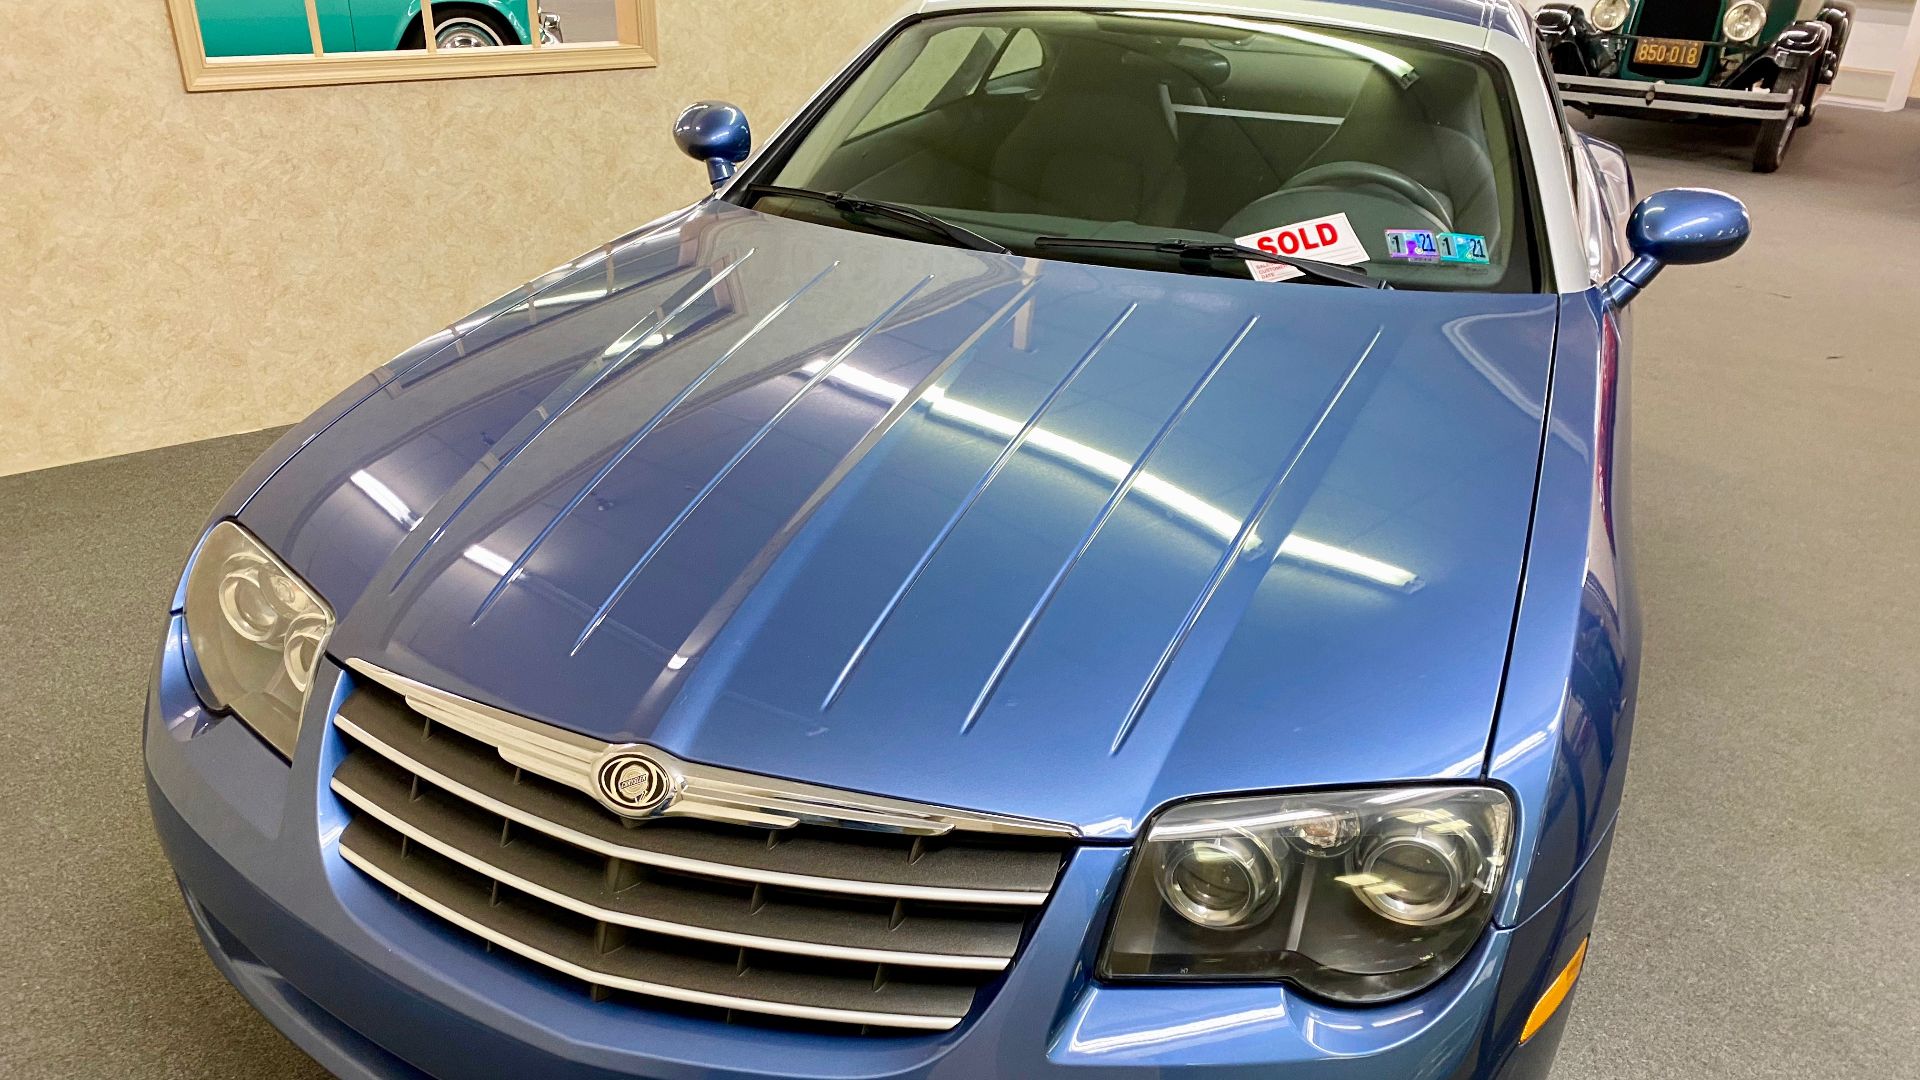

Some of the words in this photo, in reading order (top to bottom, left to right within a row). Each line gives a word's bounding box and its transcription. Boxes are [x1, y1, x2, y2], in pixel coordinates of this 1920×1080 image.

[1257, 223, 1338, 255] SOLD
[1392, 235, 1401, 253] 1
[1419, 233, 1436, 252] 21
[1443, 237, 1452, 256] 1
[1470, 238, 1486, 258] 21
